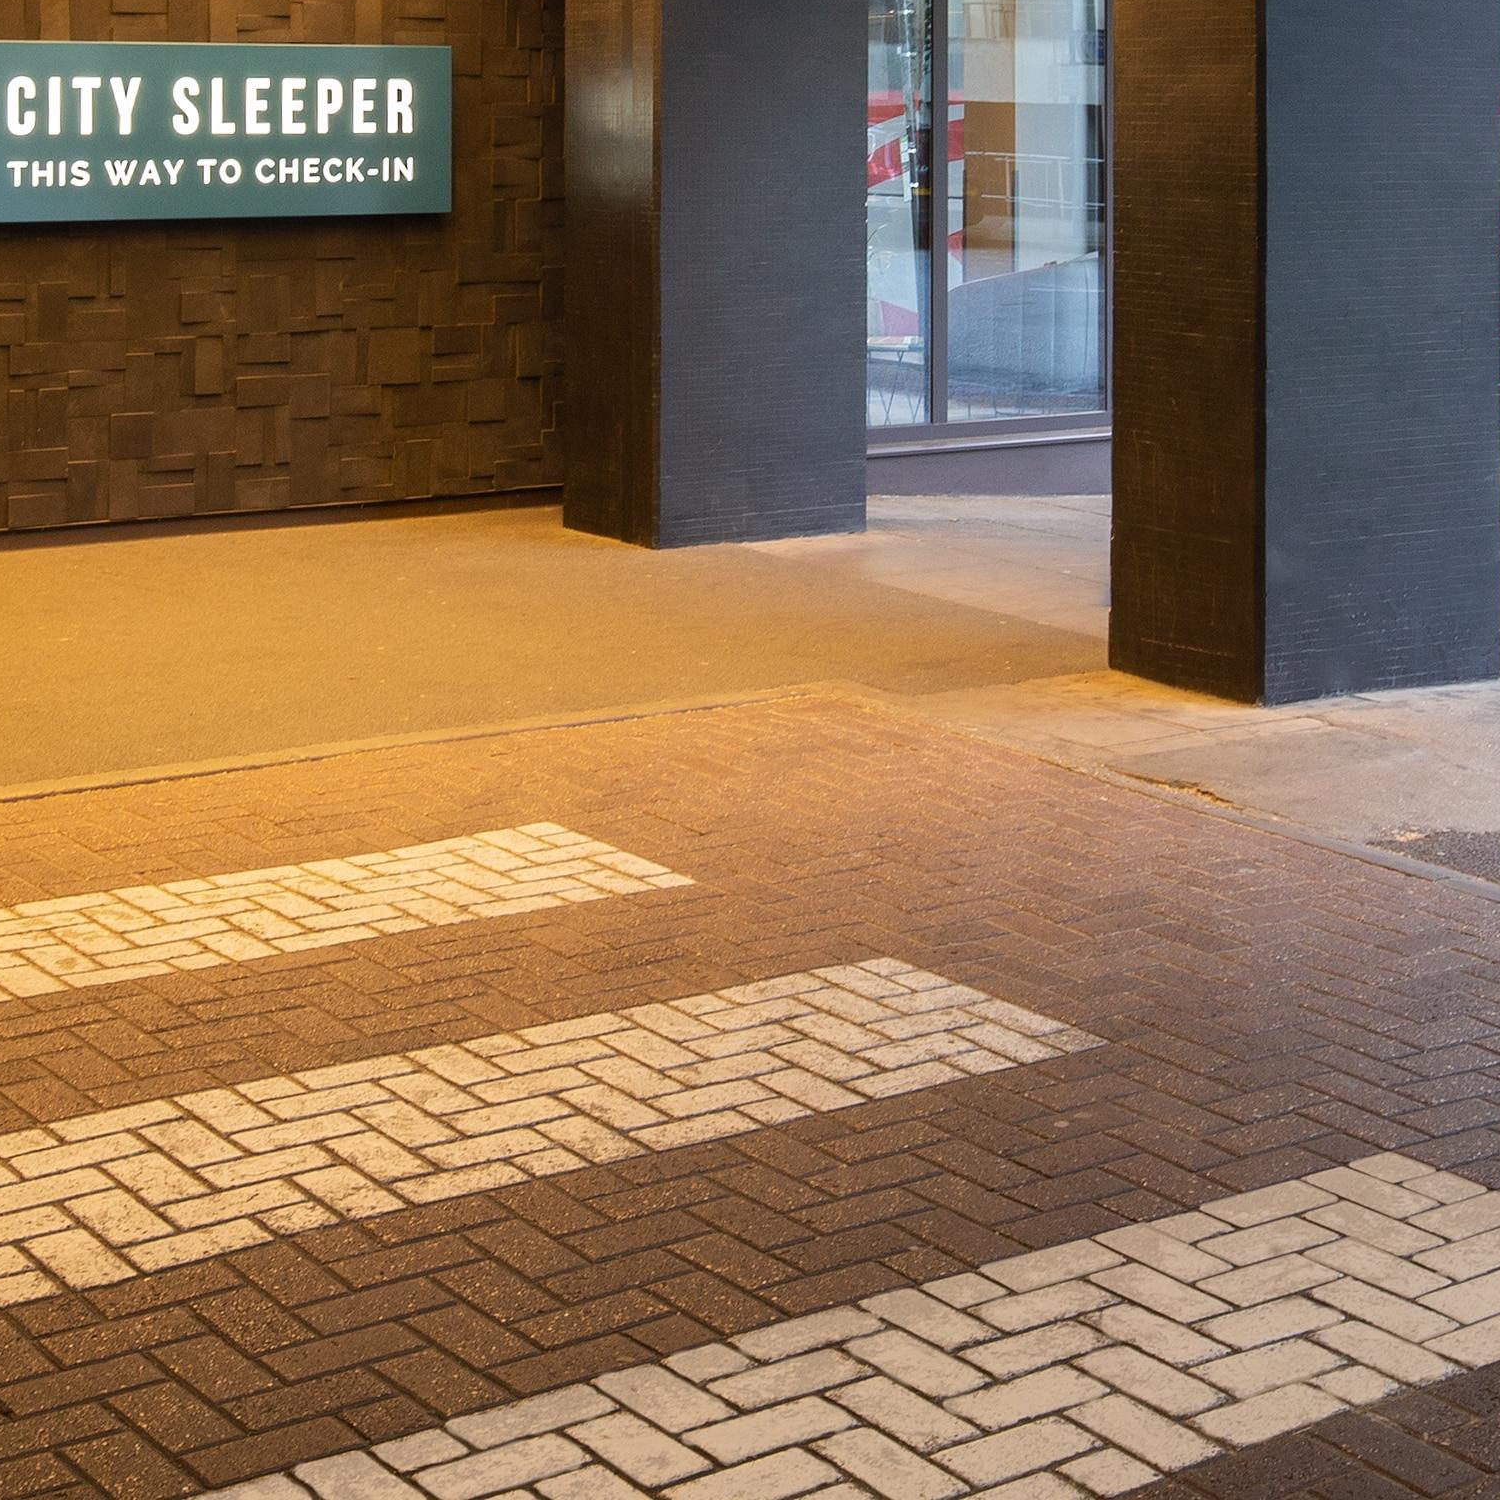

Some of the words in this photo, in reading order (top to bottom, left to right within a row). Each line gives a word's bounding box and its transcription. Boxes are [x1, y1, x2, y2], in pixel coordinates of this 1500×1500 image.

[6, 75, 143, 137] CITY
[172, 76, 414, 136] SLEEPER
[6, 160, 92, 188] THIS
[104, 159, 185, 187] WAY
[196, 158, 242, 185] TO
[254, 156, 415, 185] CHECK-IN
